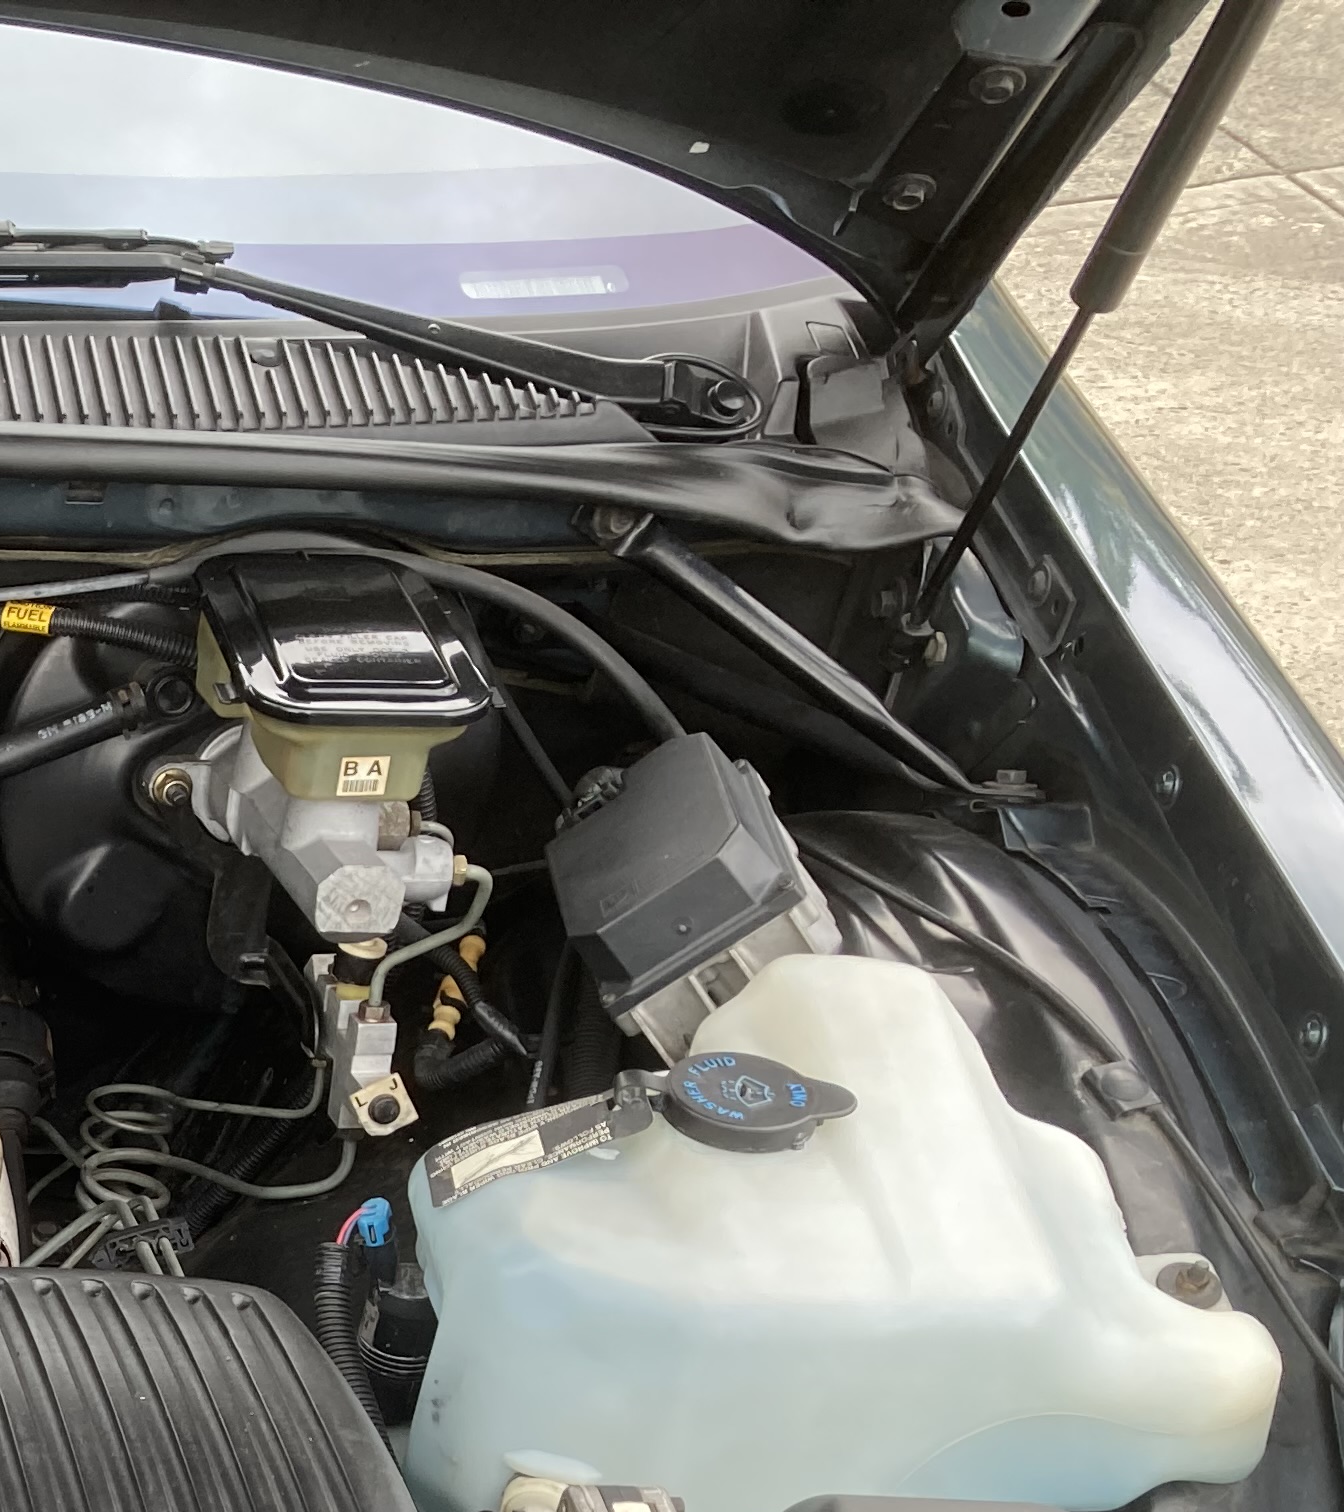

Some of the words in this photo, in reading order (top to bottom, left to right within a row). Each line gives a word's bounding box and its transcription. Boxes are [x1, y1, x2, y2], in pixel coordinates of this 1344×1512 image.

[6, 606, 48, 622] FUEL
[344, 761, 358, 776] B
[366, 760, 382, 775] A
[688, 1056, 736, 1077] FLUID
[683, 1080, 743, 1120] WASHER
[785, 1083, 807, 1107] ONLY
[600, 1134, 613, 1142] TO
[561, 1140, 599, 1159] IMPROVE
